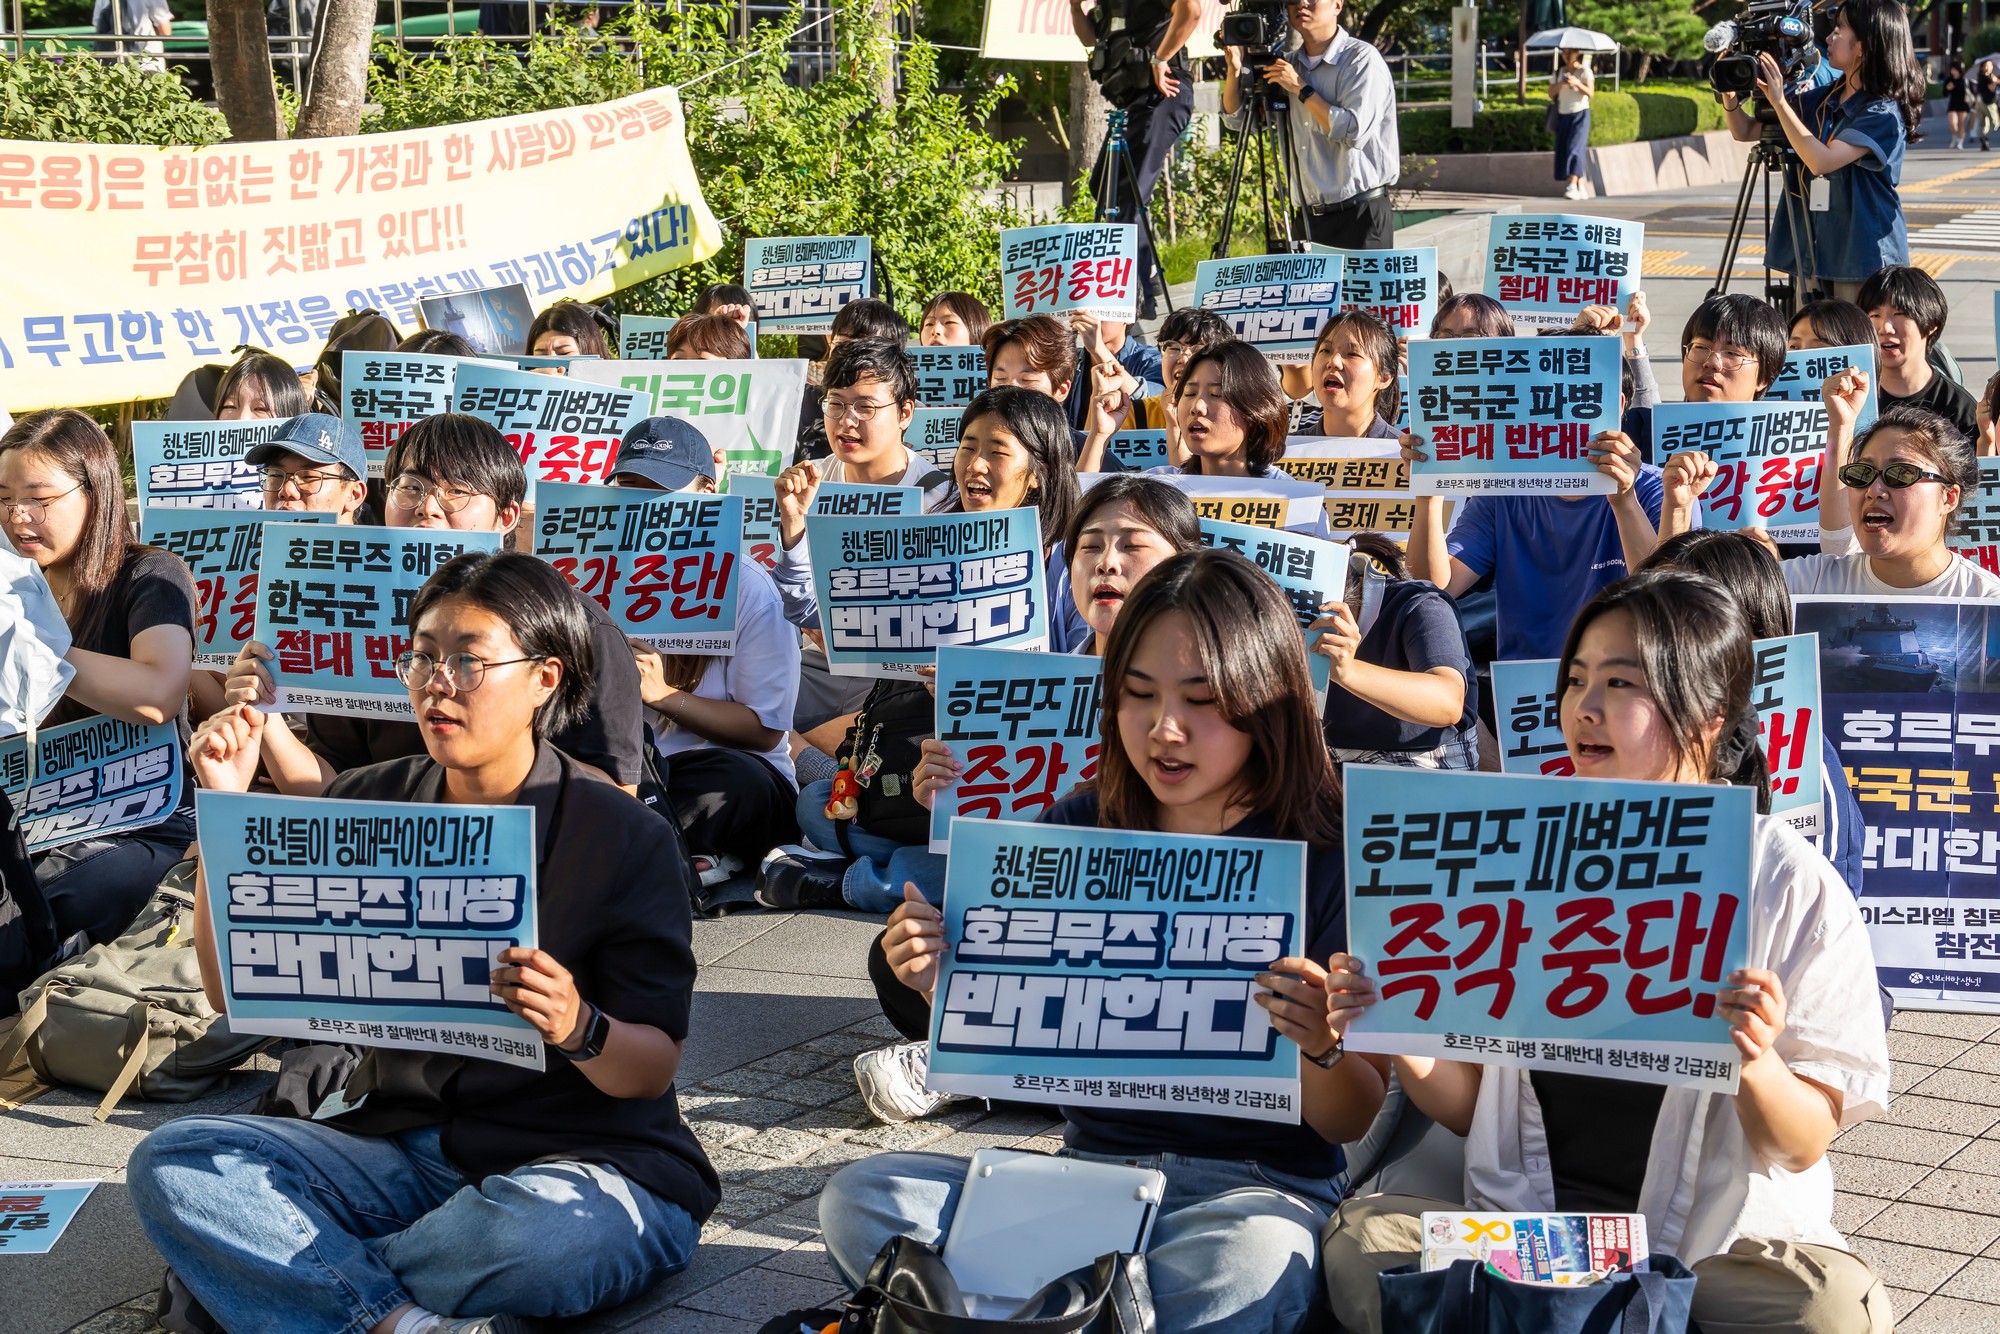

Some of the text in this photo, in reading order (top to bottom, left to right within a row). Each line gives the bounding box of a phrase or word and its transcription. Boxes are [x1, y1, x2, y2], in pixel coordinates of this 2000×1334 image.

[164, 155, 274, 209] 힘없는
[289, 149, 323, 200] 한
[335, 140, 433, 195] 가정과
[444, 133, 475, 182] 한
[486, 116, 576, 175] 사람의
[585, 98, 674, 150] 인생을
[133, 203, 467, 286] 무참히 짓밟고 있다!!
[761, 239, 857, 265] 청년들이 방패막이인가?!
[1005, 228, 1124, 275] 호르무즈 파병검토
[1506, 222, 1622, 246] 호르무즈 해협
[751, 260, 866, 288] 호르무즈 파병
[1214, 258, 1327, 287] 청년들이 방패막이인가?!
[1384, 255, 1418, 274] 해협
[1494, 247, 1629, 277] 한국군 파병
[1014, 257, 1133, 313] 즉각 중단!
[1202, 282, 1338, 309] 호르무즈 파병
[1380, 277, 1427, 303] 파병
[1498, 275, 1619, 305] 절대 반대!
[23, 309, 166, 367] 무고한
[171, 308, 222, 356] 한
[222, 295, 342, 348] 가정을
[1222, 308, 1332, 344] 대한다
[363, 361, 445, 384] 호르무즈
[1432, 348, 1591, 376] 호르무즈 해협
[350, 388, 434, 419] 한국군
[536, 389, 634, 435] 파병검토
[621, 373, 753, 416] 미국의
[1418, 384, 1519, 422] 한국군
[1529, 382, 1603, 420] 파병
[163, 430, 216, 460] 청년들이
[318, 430, 333, 450] LA
[1432, 422, 1590, 461] 절대 반대!
[1341, 462, 1389, 488] 참전
[1436, 478, 1589, 489] 호르무즈 파병 절대반대 청년학생 긴급집회
[536, 500, 723, 554] 호르무즈 파병검토
[1333, 502, 1380, 529] 경제
[285, 538, 392, 573] 호르무즈
[842, 517, 1009, 563] 청년들이 방패막이인가?!
[1255, 541, 1316, 580] 해협
[625, 551, 736, 623] 중단!
[830, 551, 1031, 600] 호르무즈 파병
[268, 579, 380, 629] 한국군
[831, 590, 1032, 650] 반대한다
[275, 630, 353, 677] 절대
[658, 639, 693, 649] 청년학생
[695, 640, 731, 650] 긴급집회
[881, 662, 913, 672] 호르무즈
[286, 693, 323, 706] 호르무즈
[324, 696, 343, 708] 파병
[345, 698, 382, 711] 절대반대
[941, 677, 1066, 740] 호르무즈
[101, 743, 174, 798] 파병
[956, 742, 1069, 820] 즉각
[245, 815, 494, 868] 청년들이 방패막이인가?!
[1355, 796, 1715, 897] 호르무즈 파병검토
[991, 845, 1263, 903] 청년들이 방패막이인가?!
[229, 872, 523, 928] 호르무즈 파병
[1862, 906, 1955, 926] 이스라엘
[958, 907, 1290, 967] 호르무즈 파병
[1377, 892, 1739, 1021] 즉각 중단!
[229, 931, 517, 1009] 반대한다
[938, 973, 1281, 1058] 반대한다
[308, 1017, 537, 1060] 호르무즈 파병 절대반대 청년학생 긴급집회
[1443, 1032, 1732, 1081] 호르무즈 파병 절대반대 청년학생 긴급집회
[1012, 1073, 1291, 1112] 호르무즈 파병 절대반대 청년학생 긴급집회
